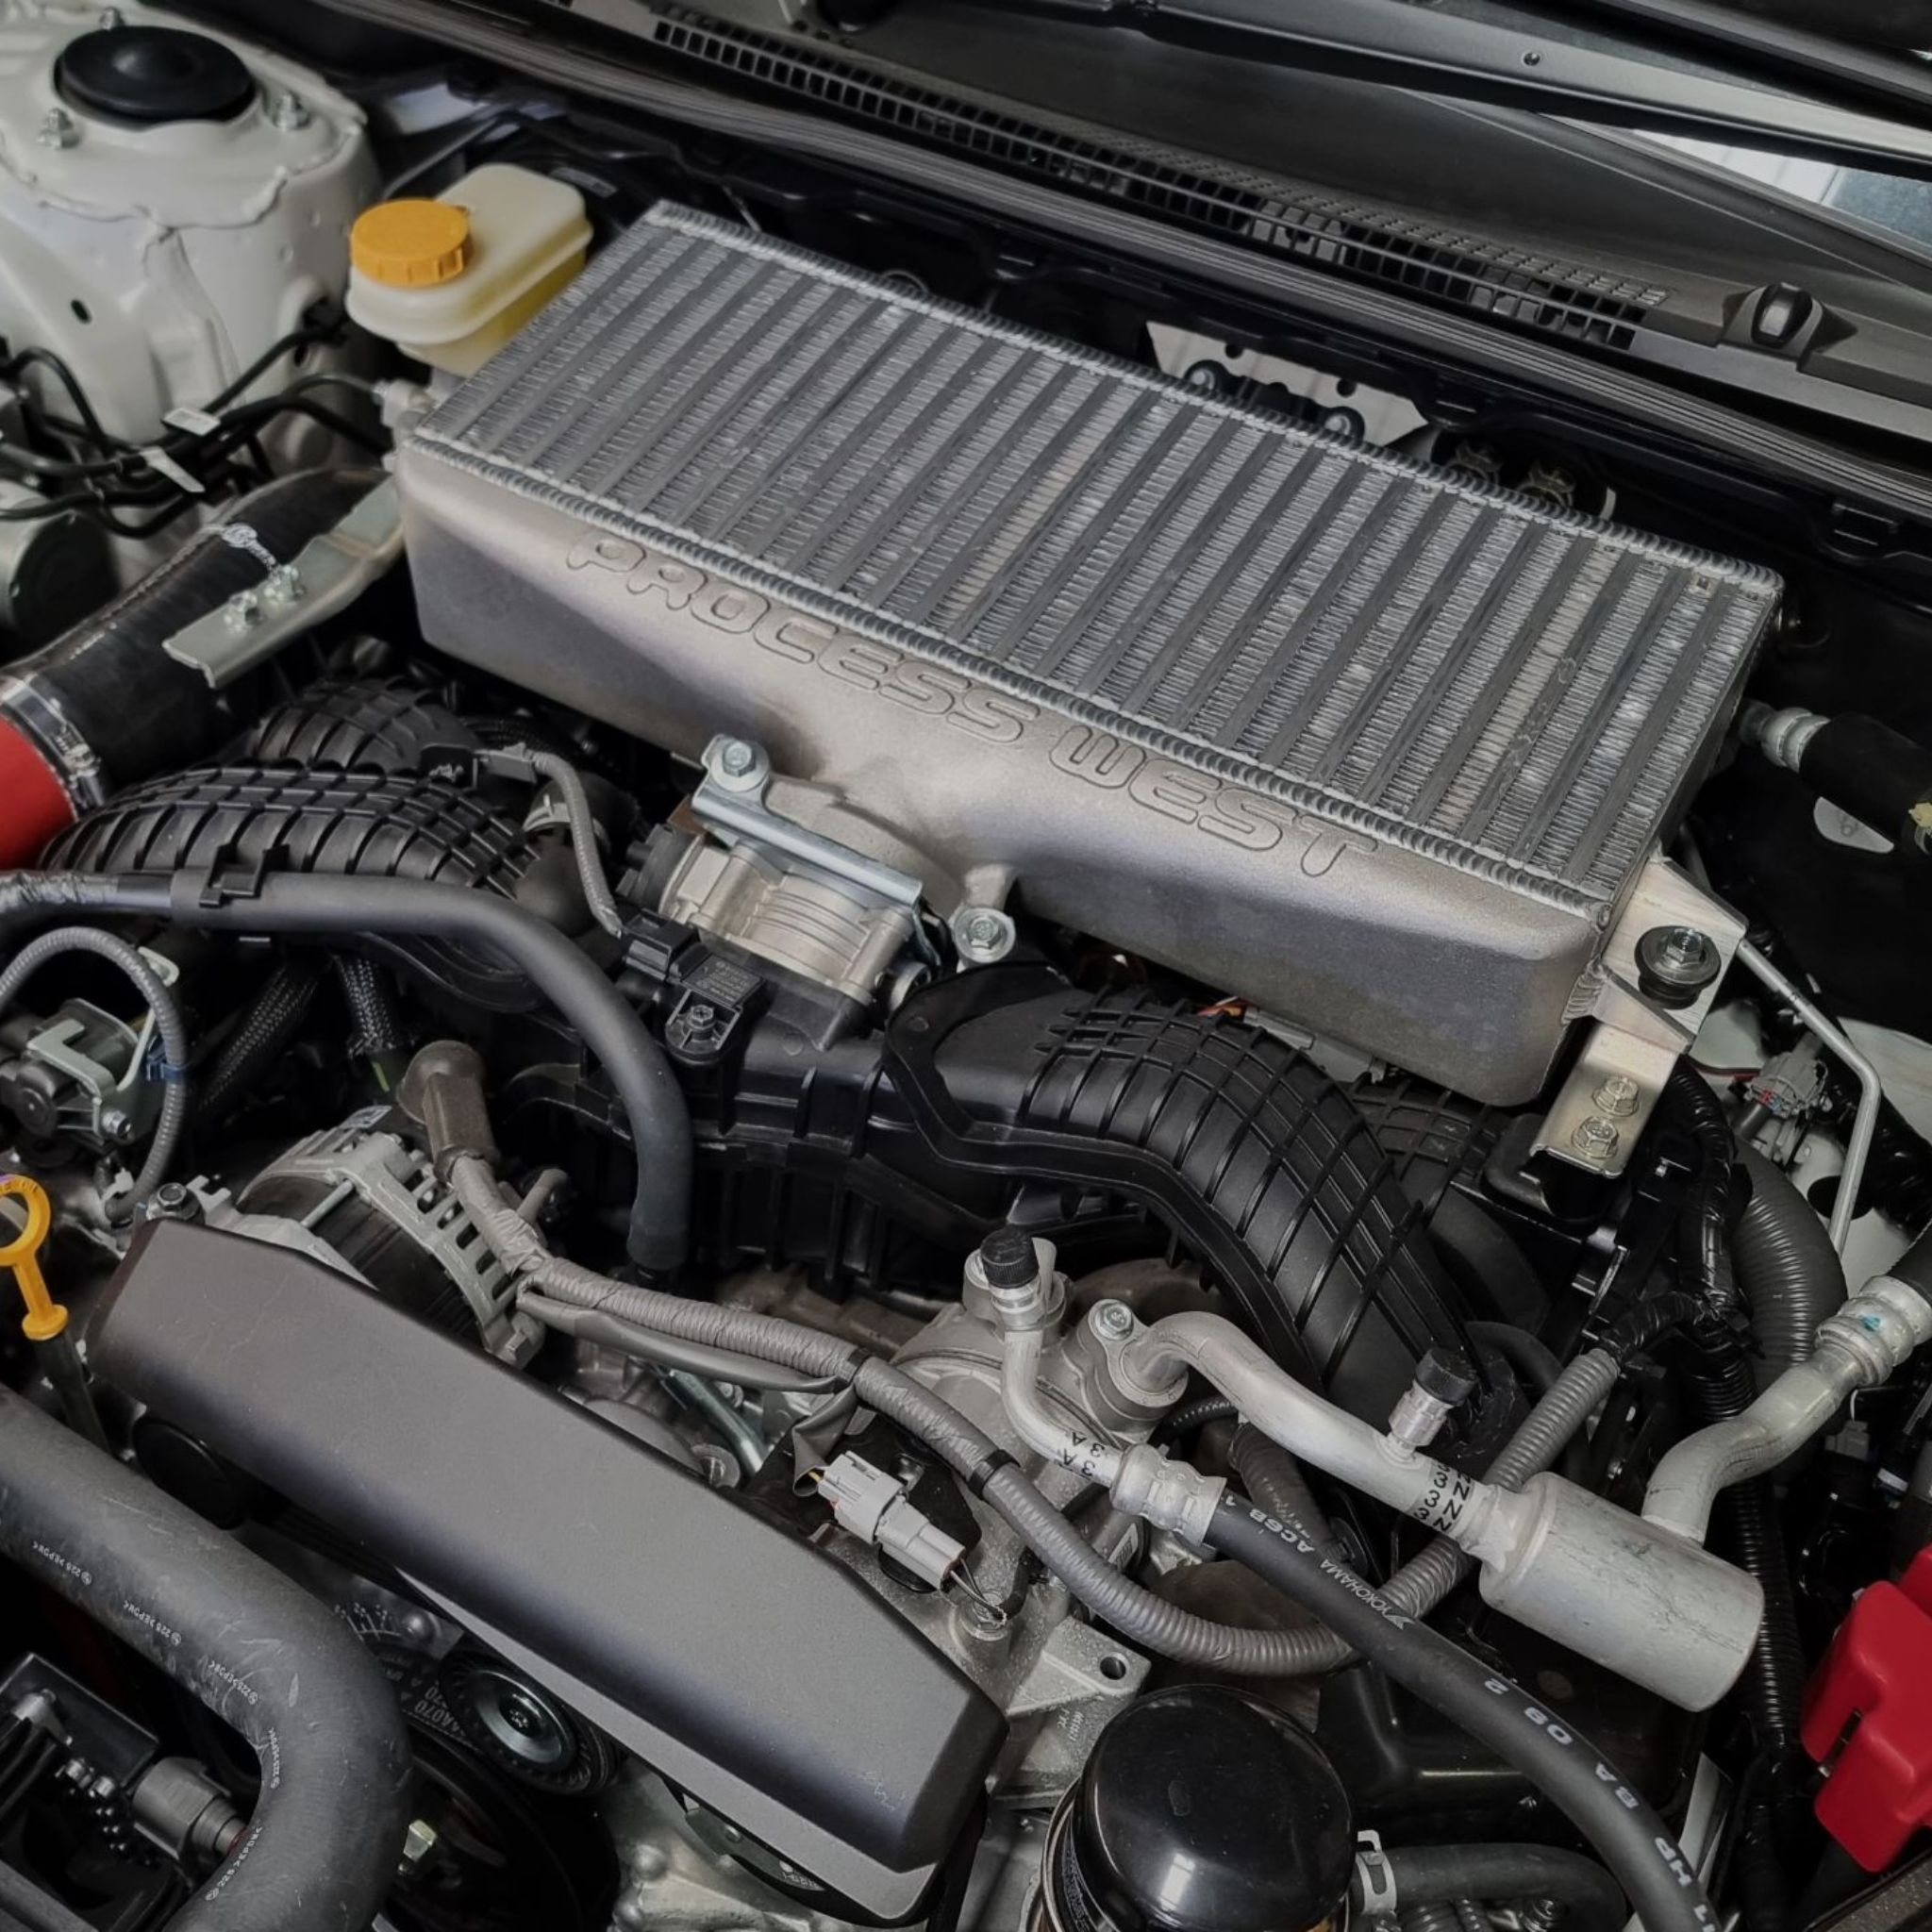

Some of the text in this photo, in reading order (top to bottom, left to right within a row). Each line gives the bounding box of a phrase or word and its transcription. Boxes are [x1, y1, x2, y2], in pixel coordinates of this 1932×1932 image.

[566, 529, 1378, 877] PROCESS WEST
[1320, 1558, 1394, 1618] YOKOHAMA
[1484, 1677, 1509, 1695] 2
[1524, 1707, 1573, 1745] 09
[1655, 1837, 1693, 1888] HP
